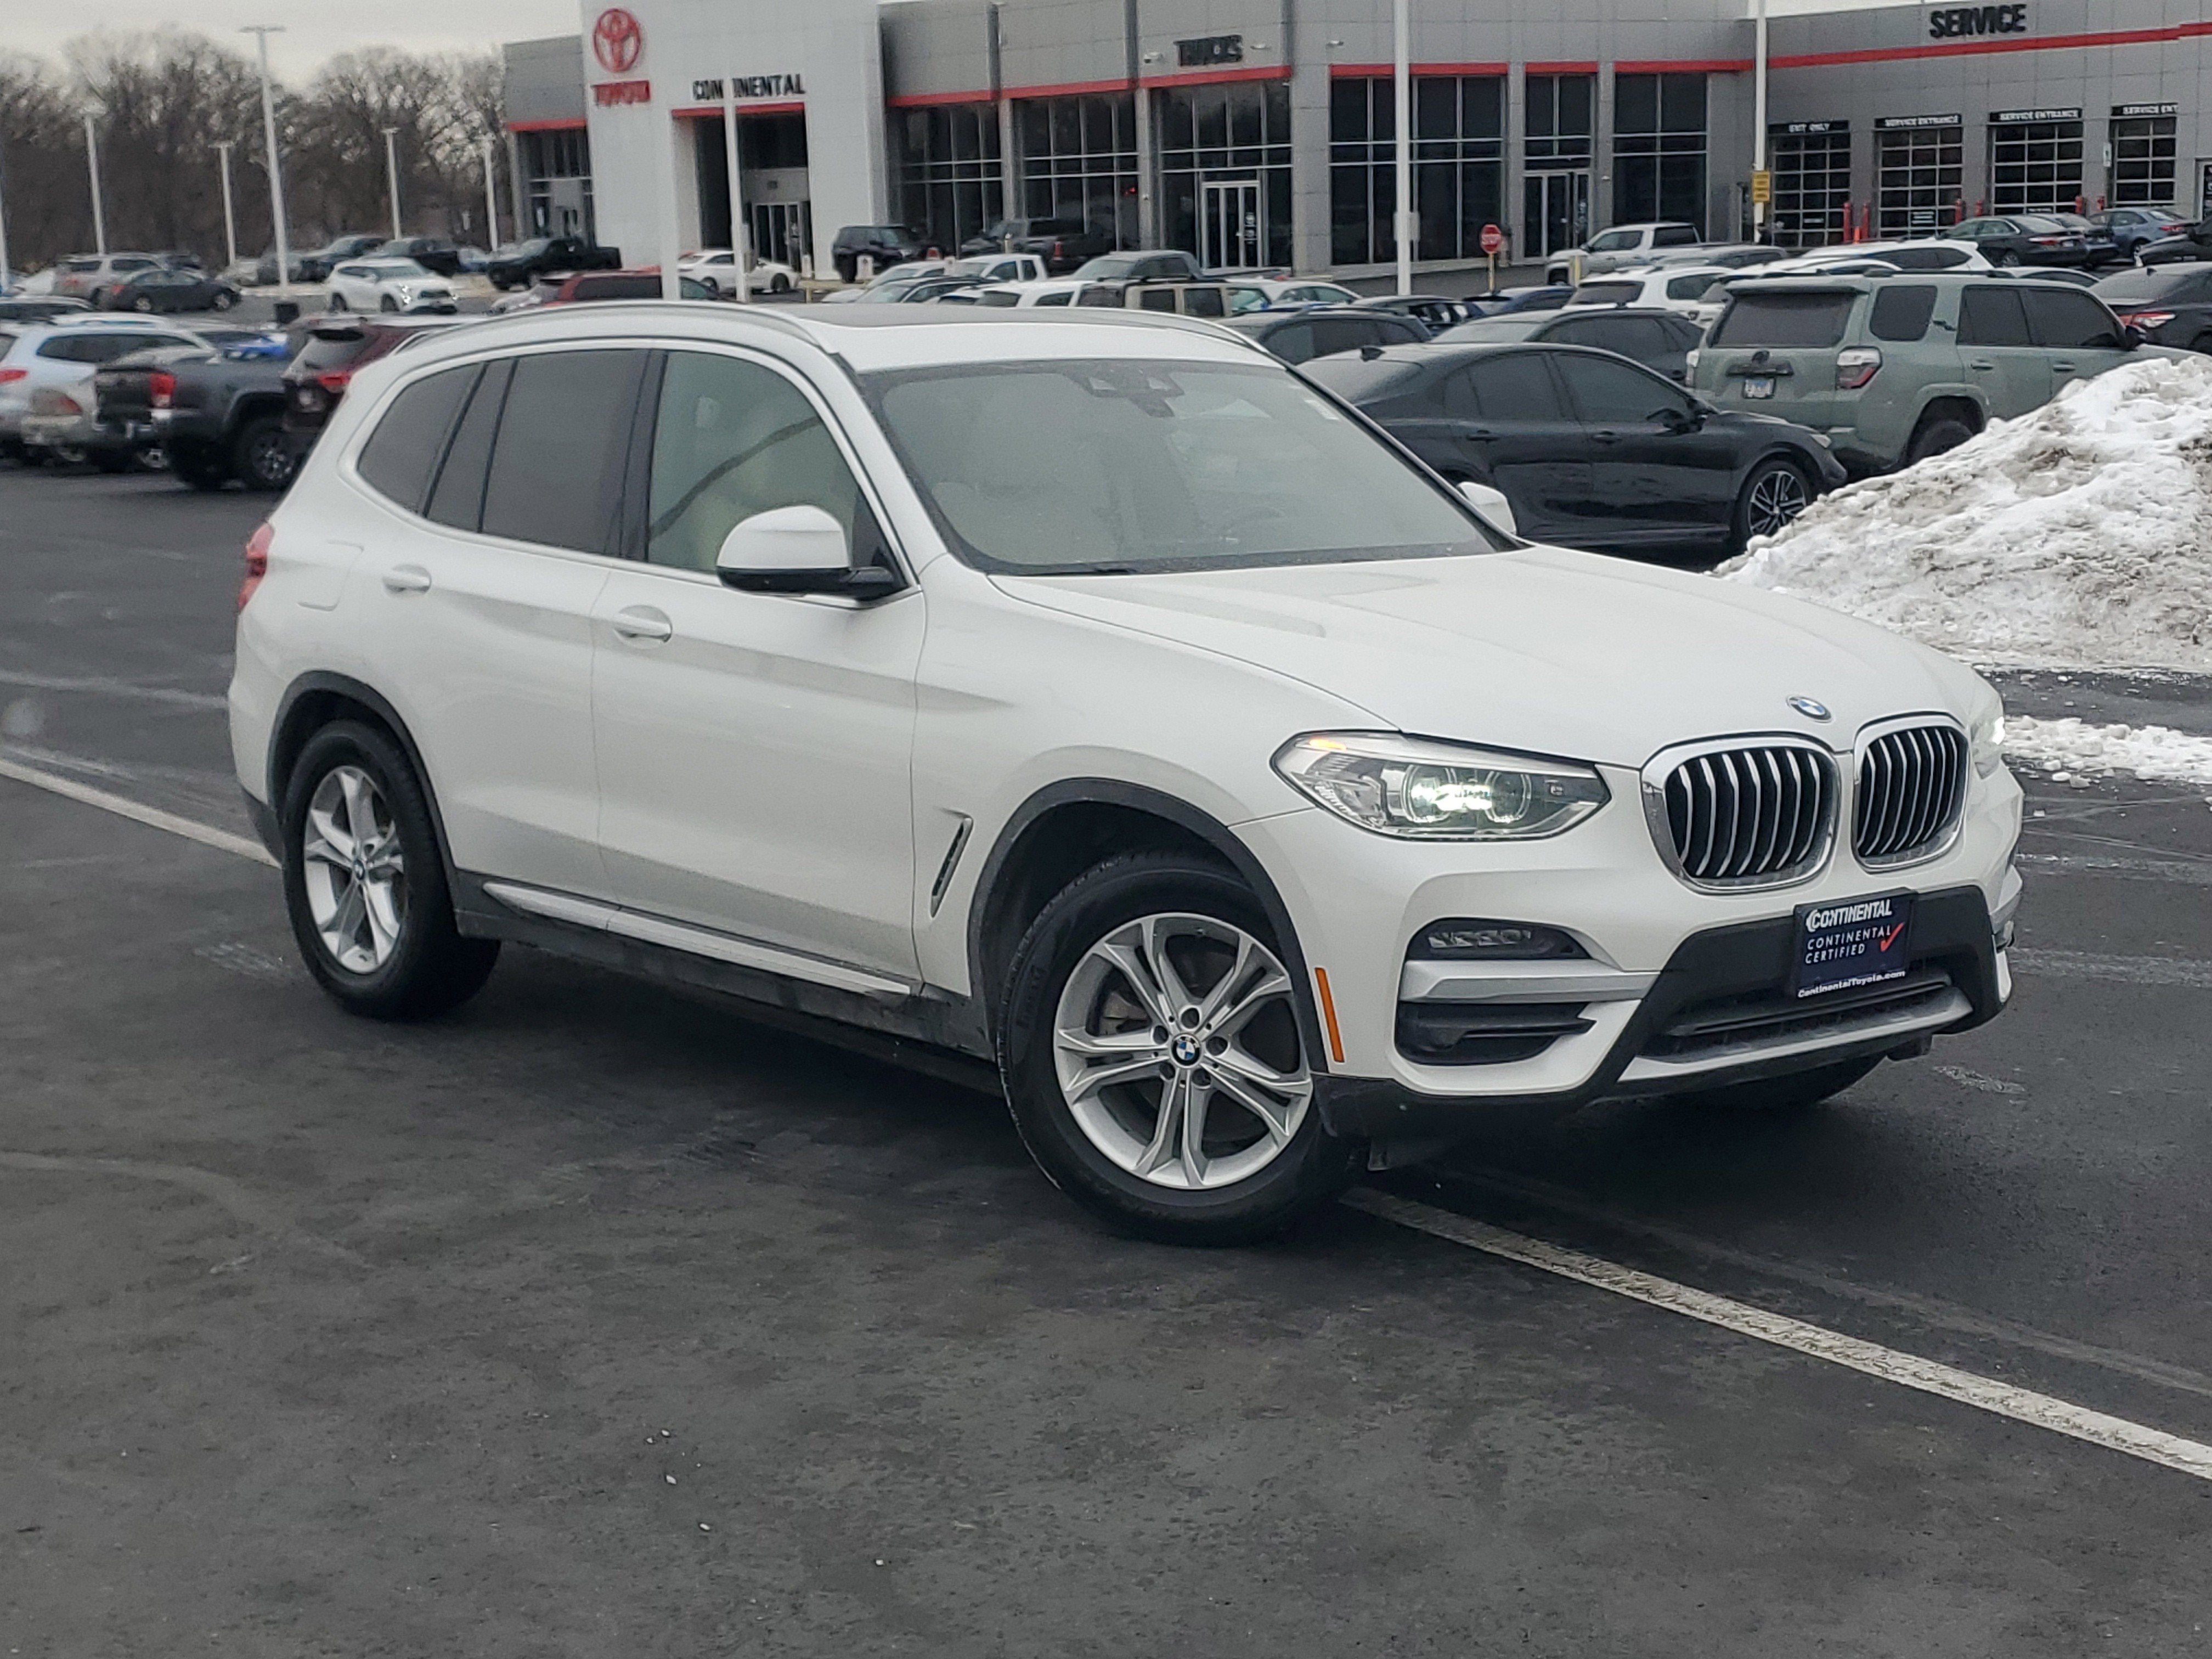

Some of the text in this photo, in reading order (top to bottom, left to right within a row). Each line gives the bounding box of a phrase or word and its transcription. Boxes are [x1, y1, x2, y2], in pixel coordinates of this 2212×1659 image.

[1929, 4, 2027, 38] SERVICE
[692, 73, 805, 100] CONINENTAL
[1806, 898, 1893, 932] CONTINENTAL
[1807, 924, 1892, 951] CONTINENTAL
[1805, 943, 1865, 964] CERTIFIED
